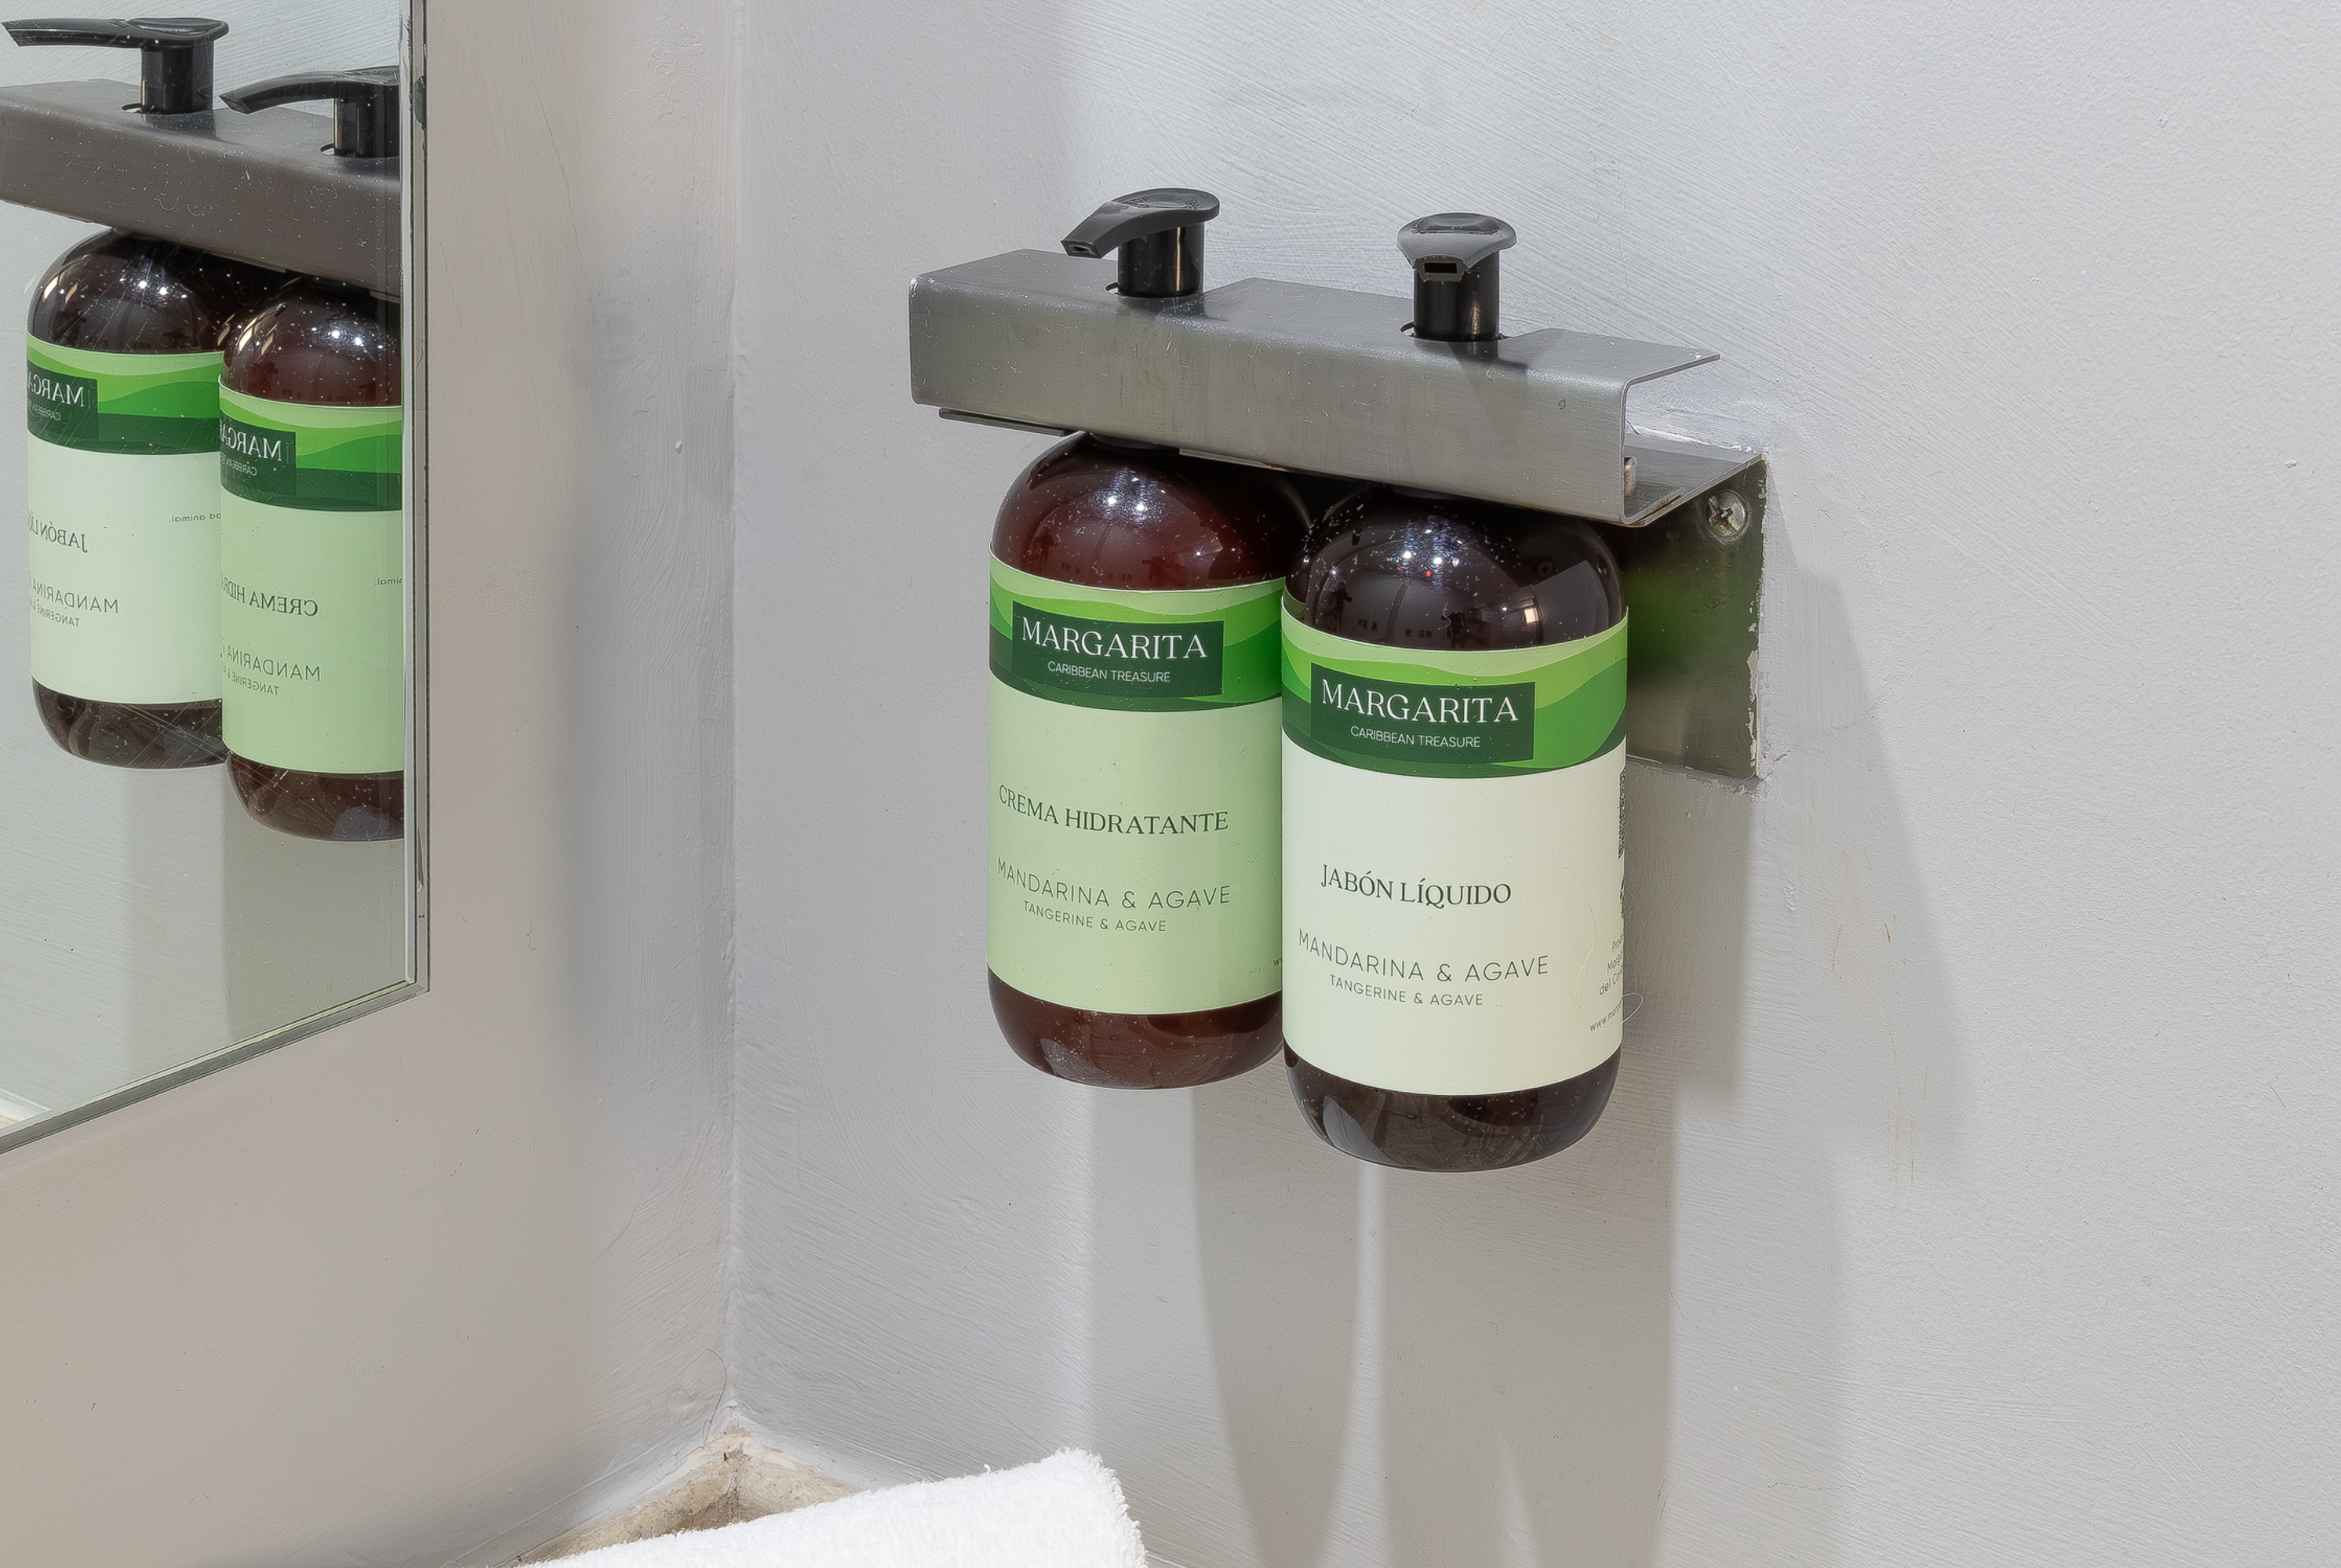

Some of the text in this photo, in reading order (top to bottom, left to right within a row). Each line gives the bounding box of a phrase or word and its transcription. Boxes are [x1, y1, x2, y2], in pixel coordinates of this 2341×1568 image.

[1021, 617, 1207, 659] MARGARITA
[1047, 660, 1170, 683] CARIBBEAN TREASURE
[1322, 678, 1519, 723] MARGARITA
[1350, 726, 1480, 748] CARIBBEAN TREASURE
[999, 784, 1229, 835] CREMA HIDRATANTE
[997, 857, 1230, 909] MANDARINA & AGAVE
[1321, 864, 1512, 909] JABÓN LÍQUIDO
[1023, 900, 1167, 932] TANGERINE & AGAVE
[1299, 928, 1549, 982] MANDARINA & AGAVE
[1330, 973, 1483, 1006] TANGERINE & AGAVE
[1599, 977, 1611, 995] del
